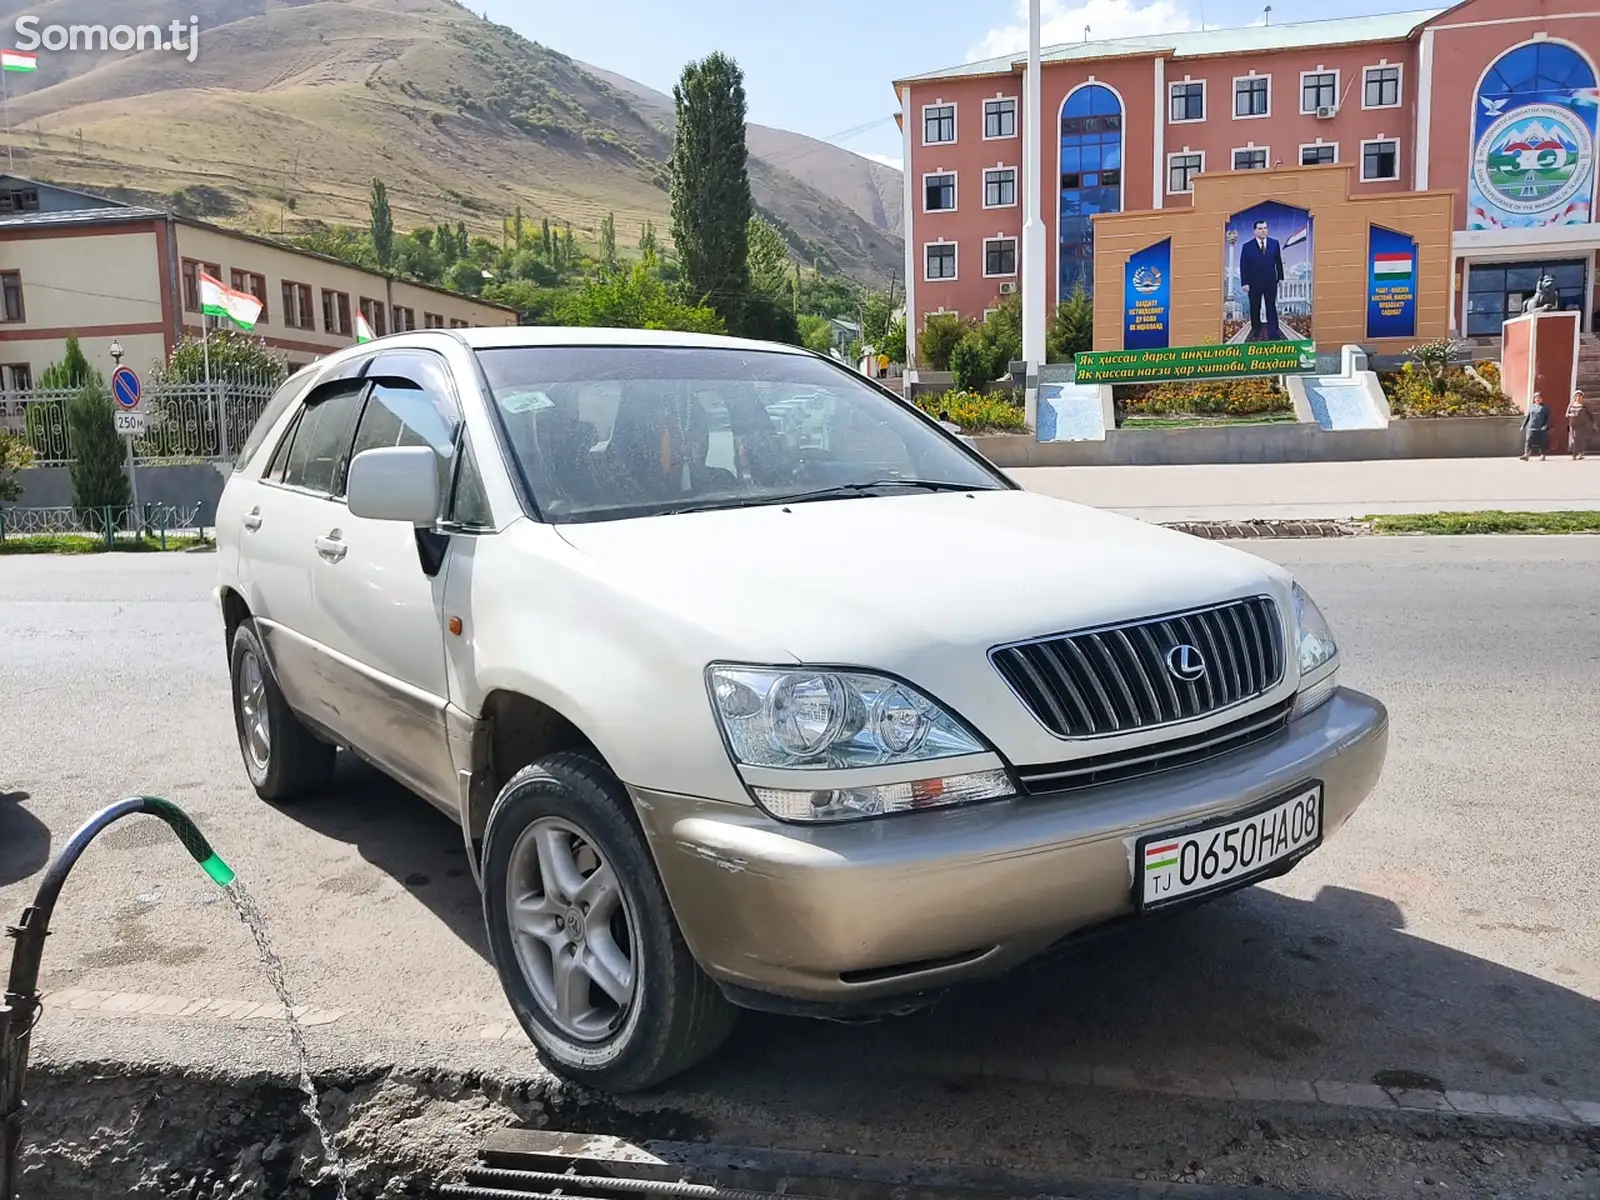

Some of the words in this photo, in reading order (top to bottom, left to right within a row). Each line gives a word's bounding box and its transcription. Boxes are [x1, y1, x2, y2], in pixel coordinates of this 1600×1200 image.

[1079, 355, 1094, 365] Як
[1098, 353, 1137, 366] ҳиссаи
[1142, 351, 1176, 363] дарси
[1077, 369, 1093, 380] Як
[1095, 368, 1135, 381] қиссаи
[1137, 366, 1171, 377] нағзи
[1174, 364, 1195, 377] ҳар
[1250, 358, 1298, 371] Ваҳдат
[1152, 873, 1172, 894] TJ
